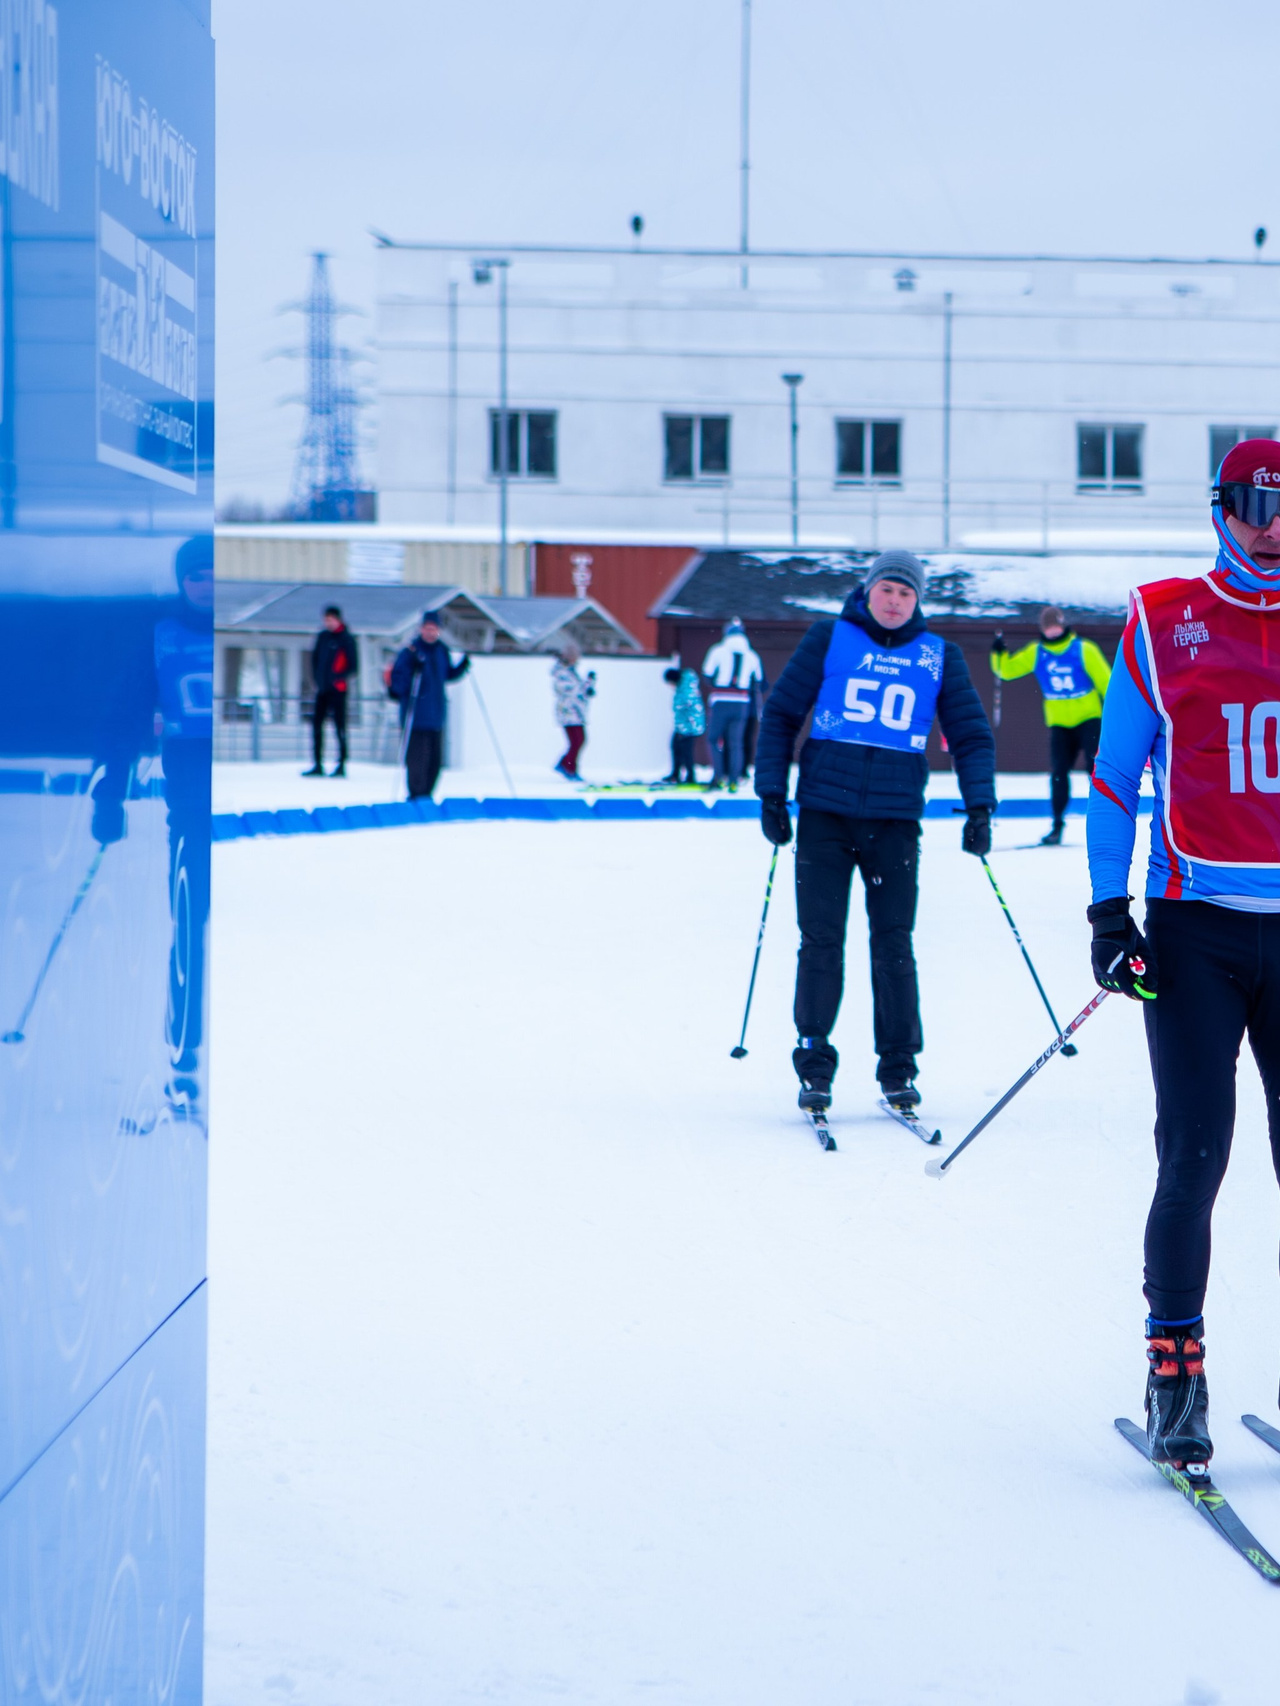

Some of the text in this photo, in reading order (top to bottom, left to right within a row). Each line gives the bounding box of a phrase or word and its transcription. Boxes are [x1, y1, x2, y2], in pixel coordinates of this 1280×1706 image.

[95, 53, 198, 238] ЮГО-ВОСТОК
[1174, 621, 1205, 635] ЛЫЖНЯ
[1173, 629, 1210, 647] ГЕРОЕВ
[876, 654, 911, 667] ЛЫЖНЯ
[1051, 676, 1075, 691] 94
[842, 678, 916, 732] 50
